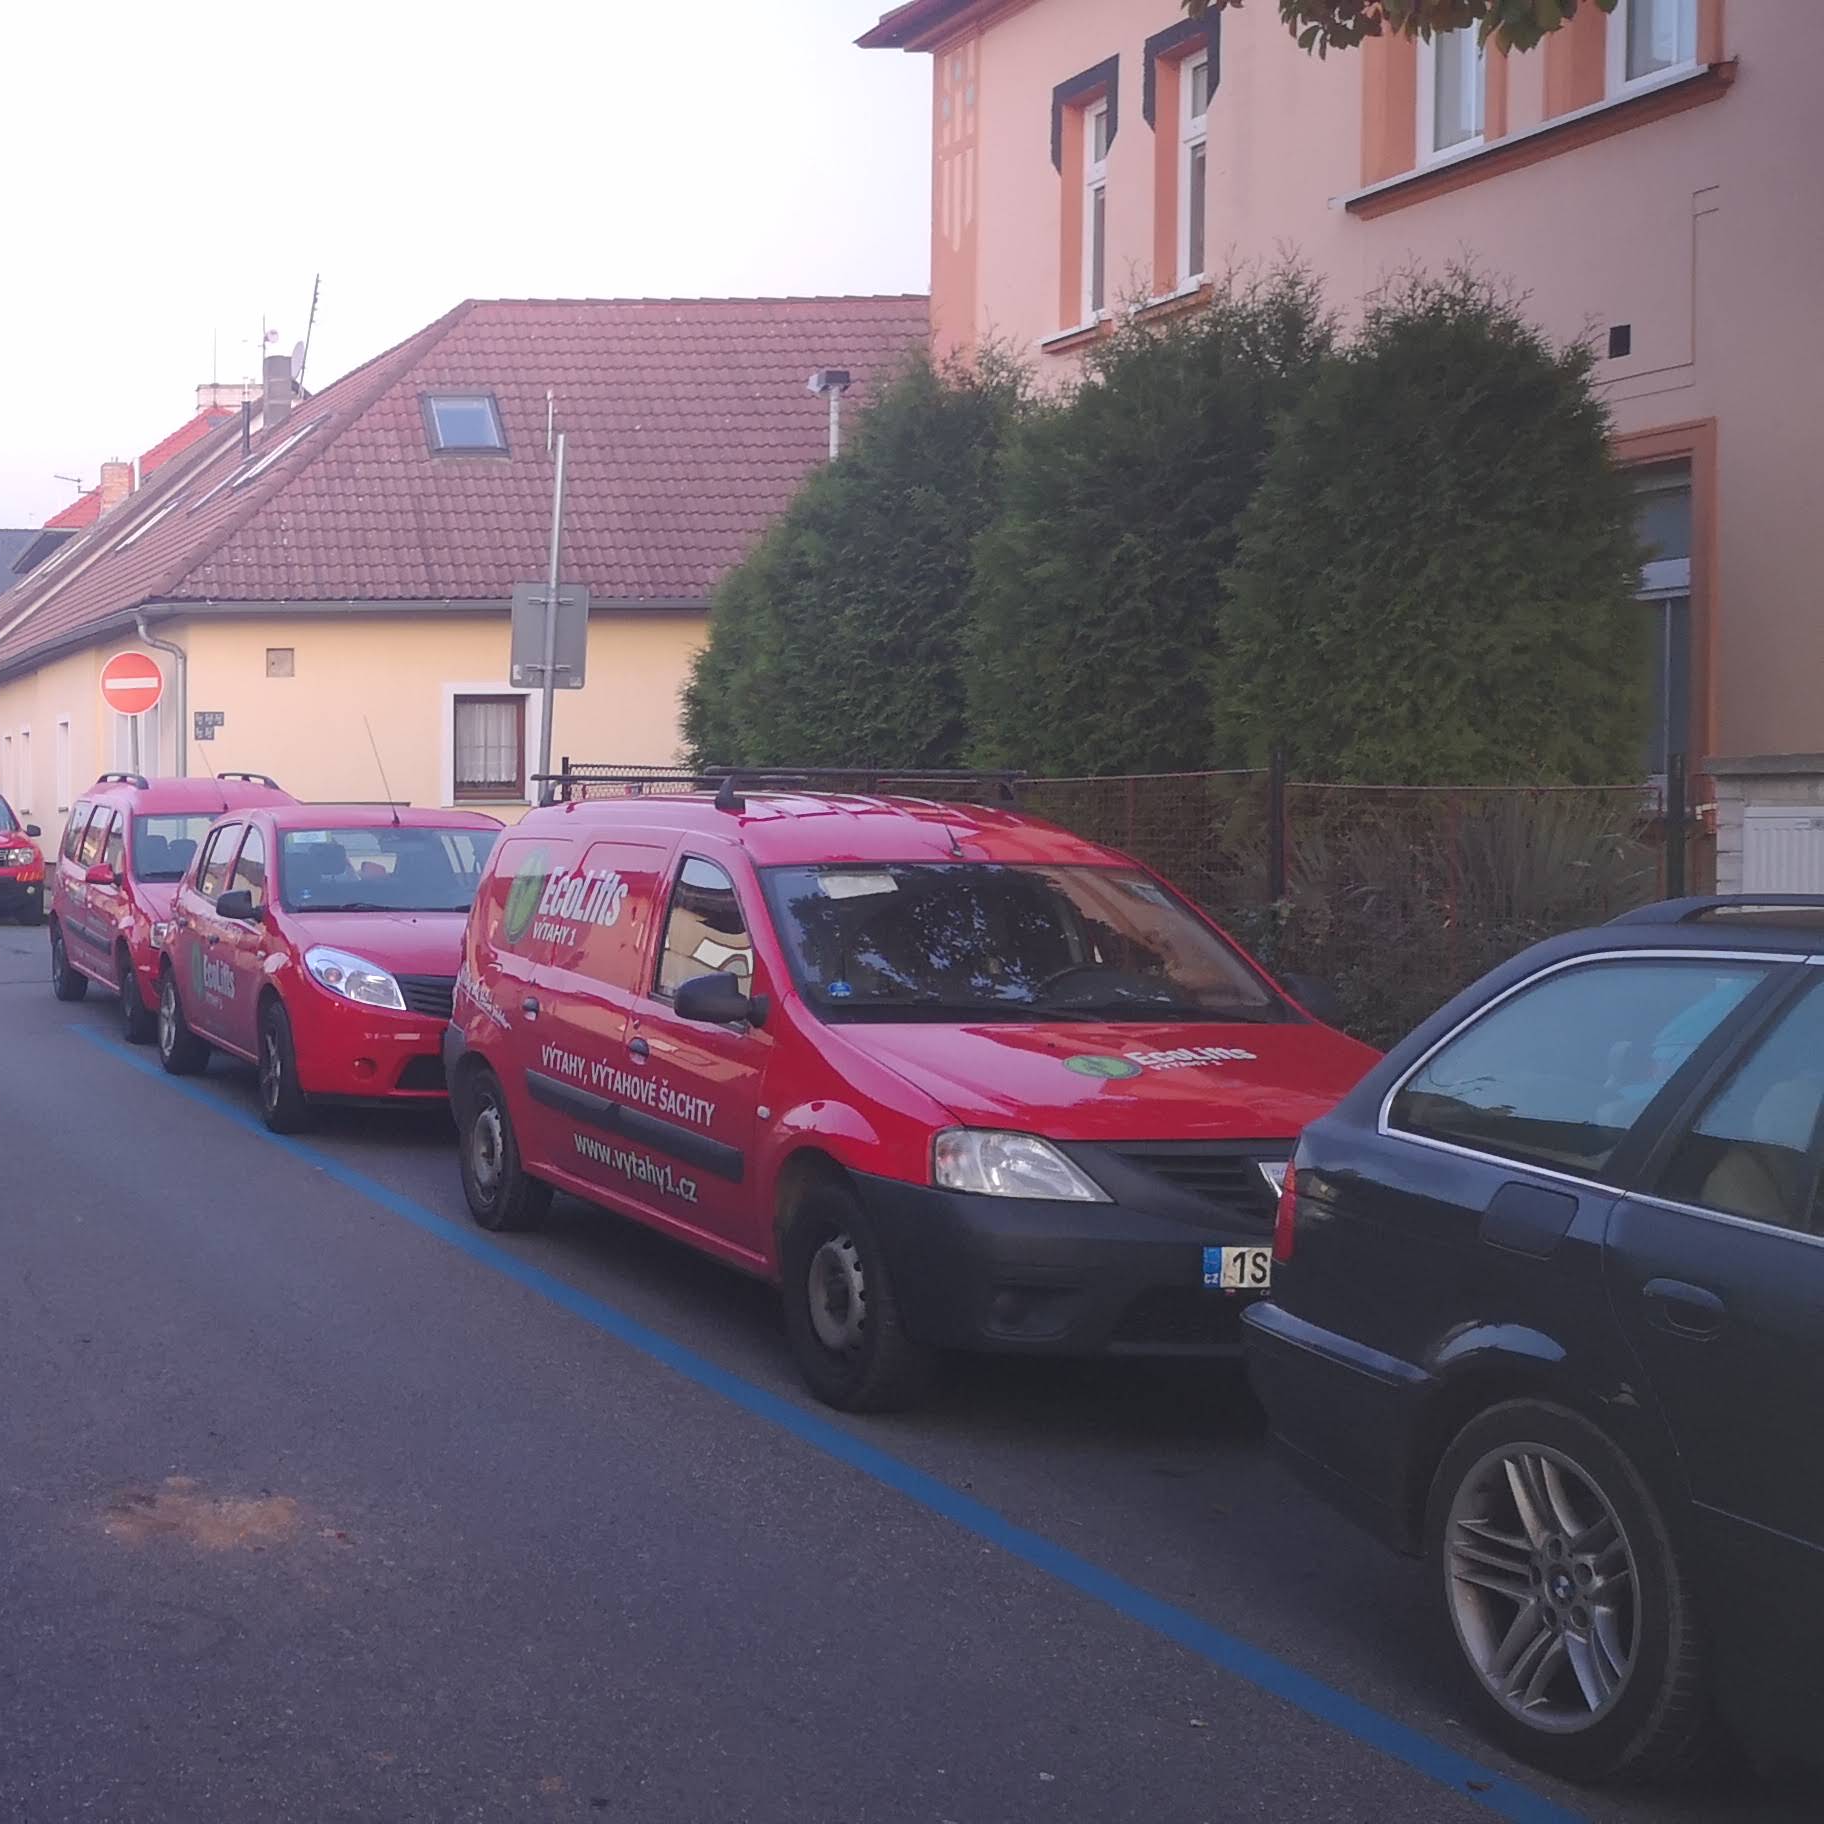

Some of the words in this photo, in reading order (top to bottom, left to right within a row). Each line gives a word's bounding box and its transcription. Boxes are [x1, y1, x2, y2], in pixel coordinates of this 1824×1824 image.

[538, 865, 629, 927] EcoLifts
[567, 928, 577, 947] 1
[541, 1041, 588, 1085] VÝTAHY,
[591, 1058, 657, 1107] VÝTAHOVÉ
[658, 1078, 716, 1127] ŠACHTY
[573, 1132, 699, 1204] www.vytahy1.cz
[1203, 1273, 1220, 1285] CZ
[1232, 1250, 1269, 1285] 1S
